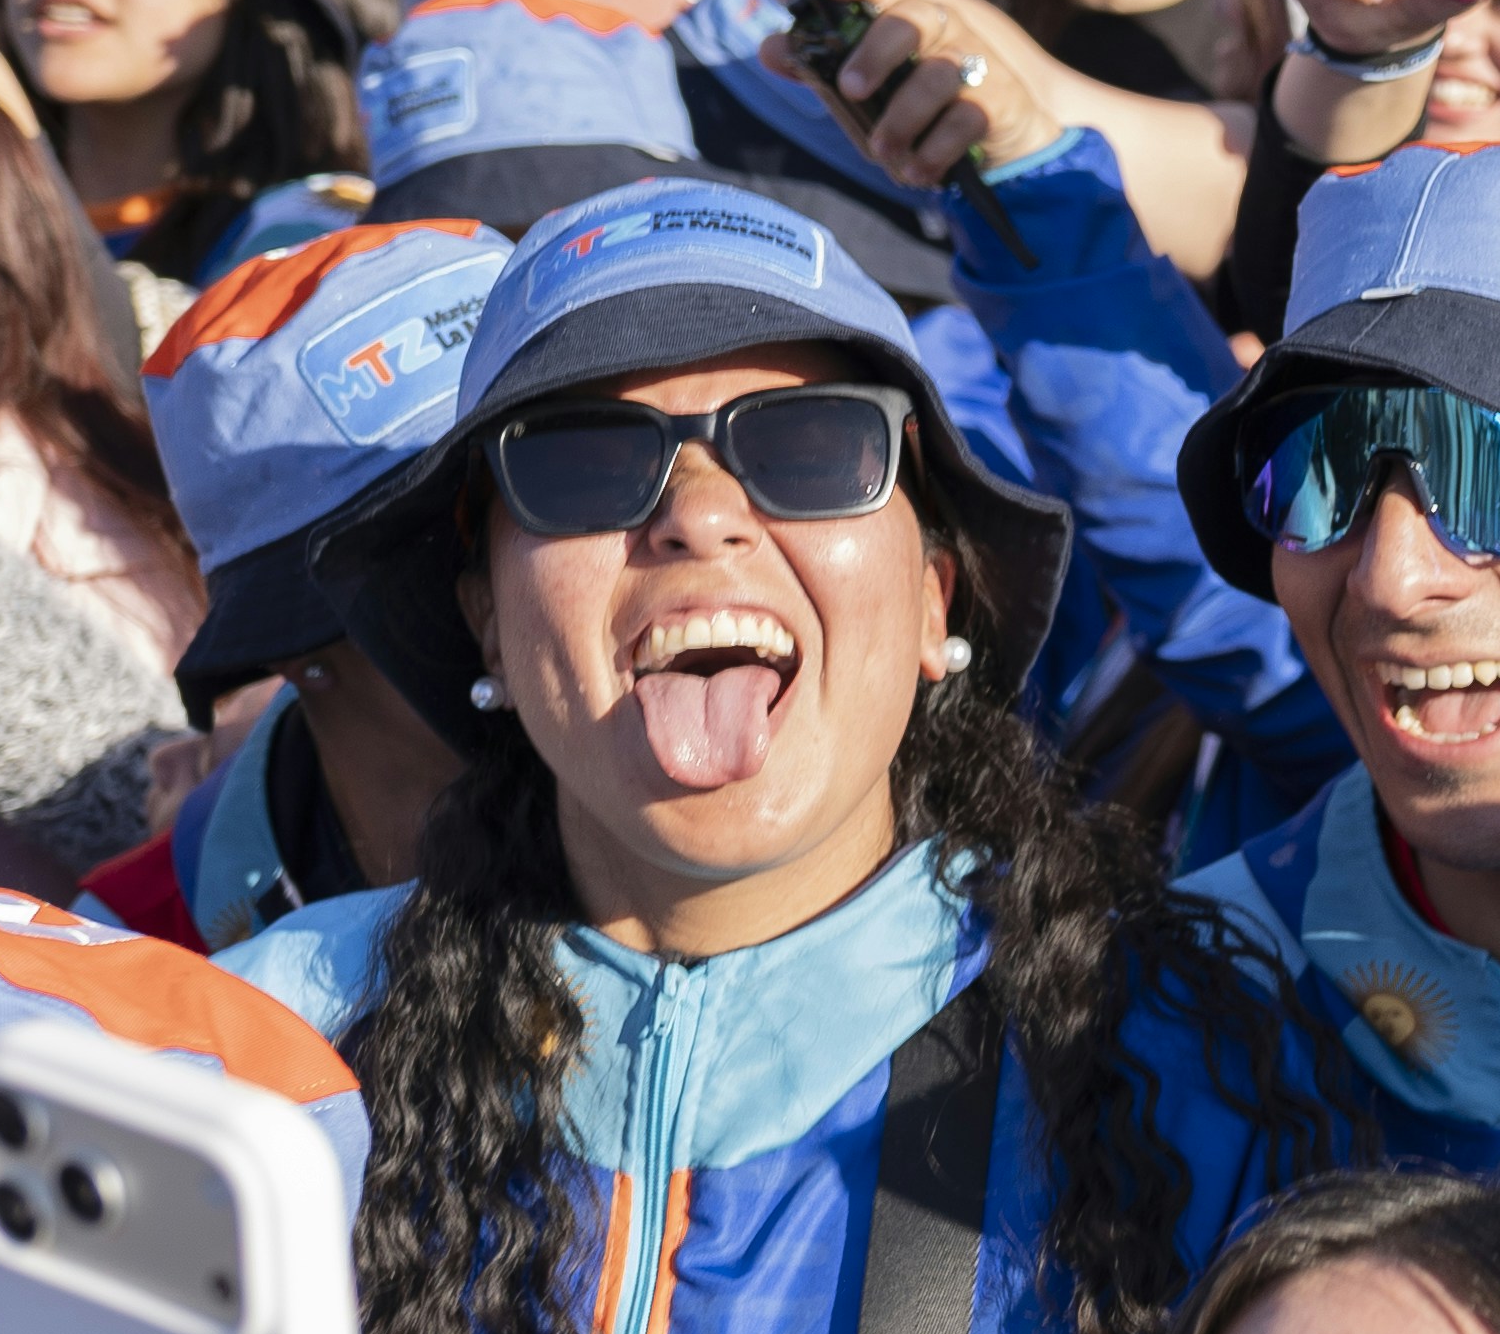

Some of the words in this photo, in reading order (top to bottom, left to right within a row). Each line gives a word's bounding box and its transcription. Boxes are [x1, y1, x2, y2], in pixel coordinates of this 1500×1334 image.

[688, 217, 814, 263] Matanza
[434, 331, 467, 351] La
[317, 317, 444, 417] MTZ
